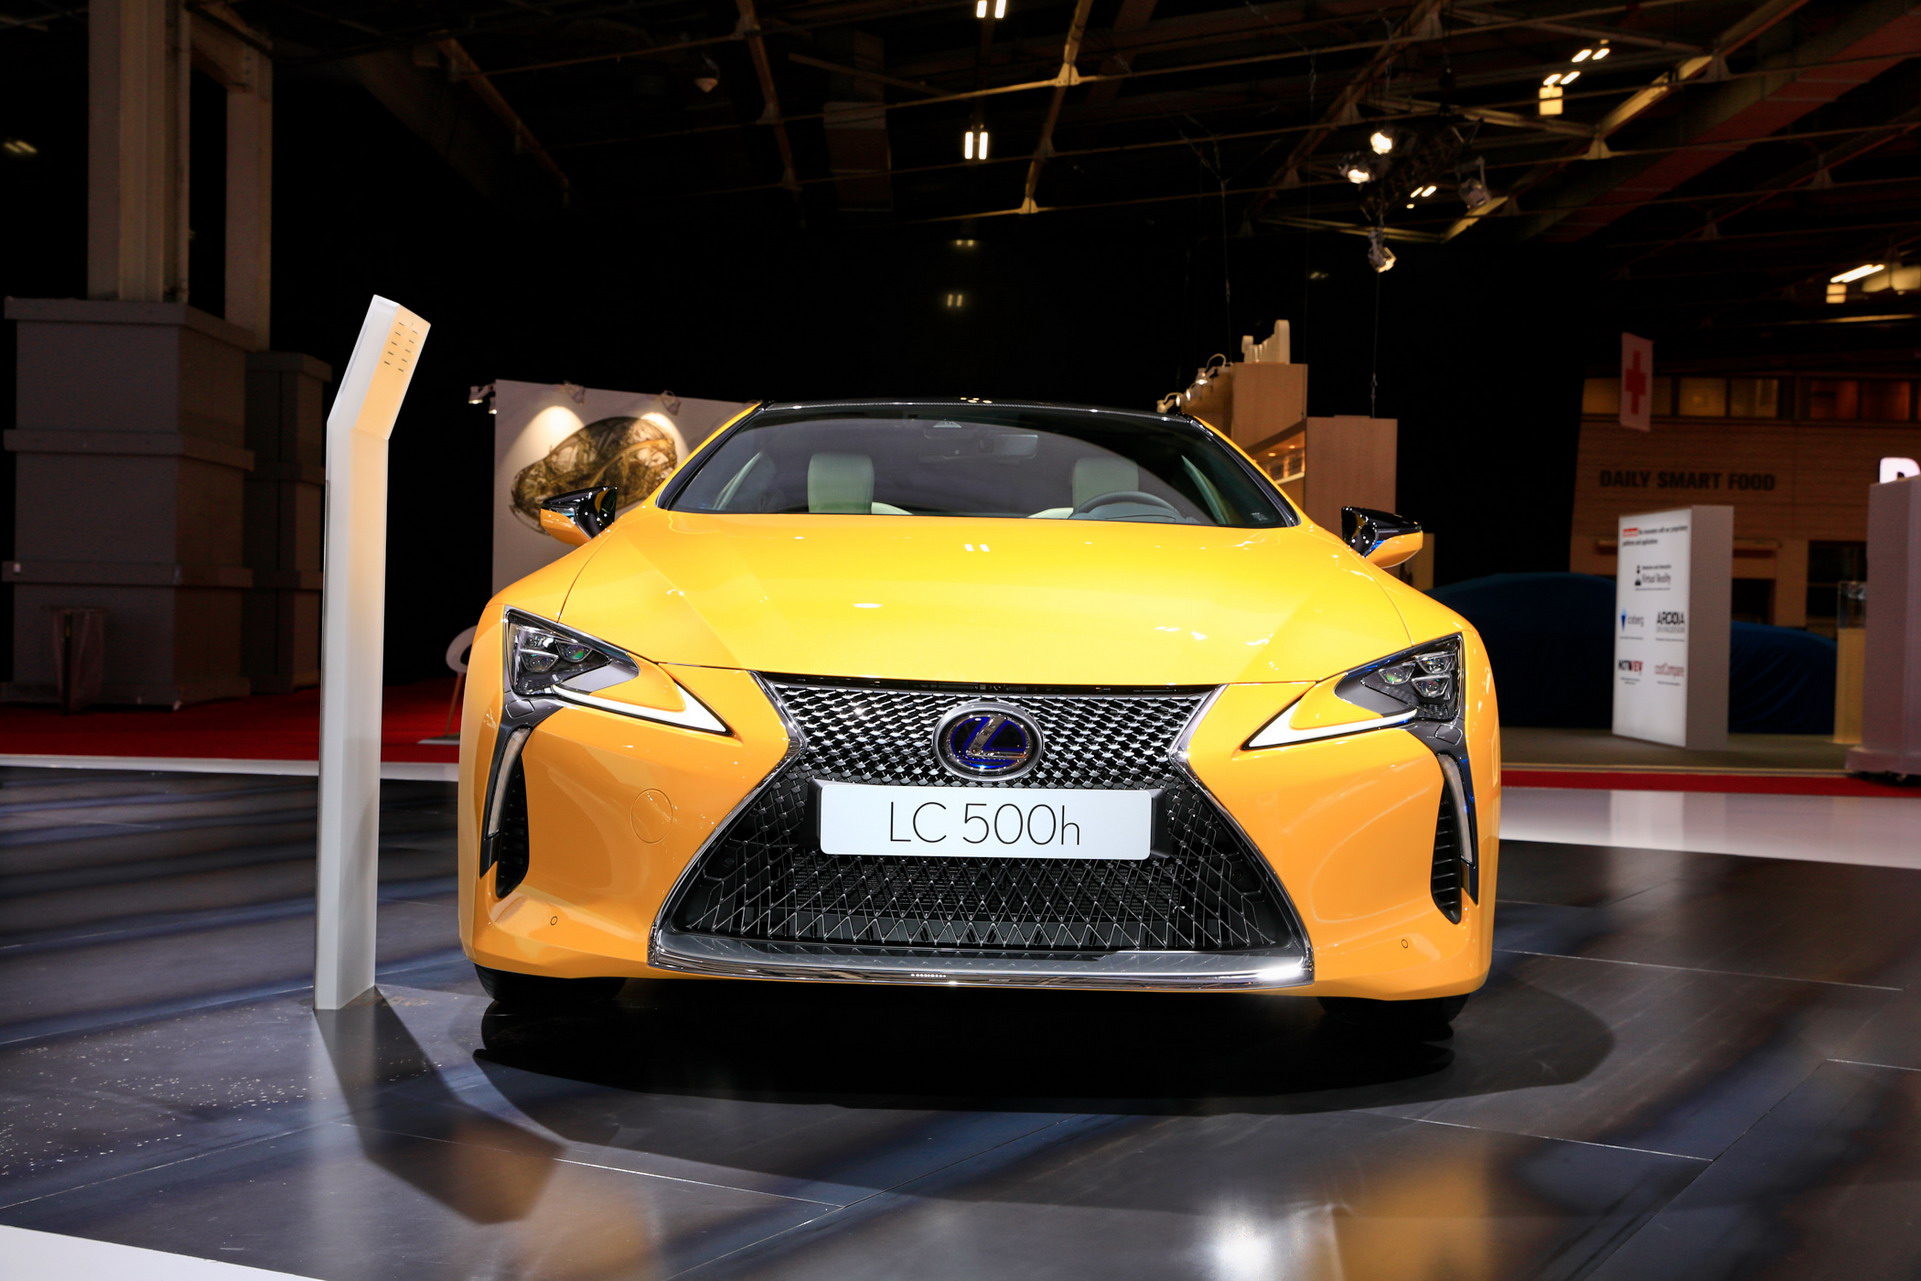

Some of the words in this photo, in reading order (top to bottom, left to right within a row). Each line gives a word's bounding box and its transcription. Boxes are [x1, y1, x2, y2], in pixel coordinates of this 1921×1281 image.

[1600, 470, 1651, 488] DAILY
[1657, 471, 1722, 490] SMART
[1727, 472, 1776, 491] FOOD
[889, 801, 947, 843] LC
[962, 803, 1081, 846] 500h
